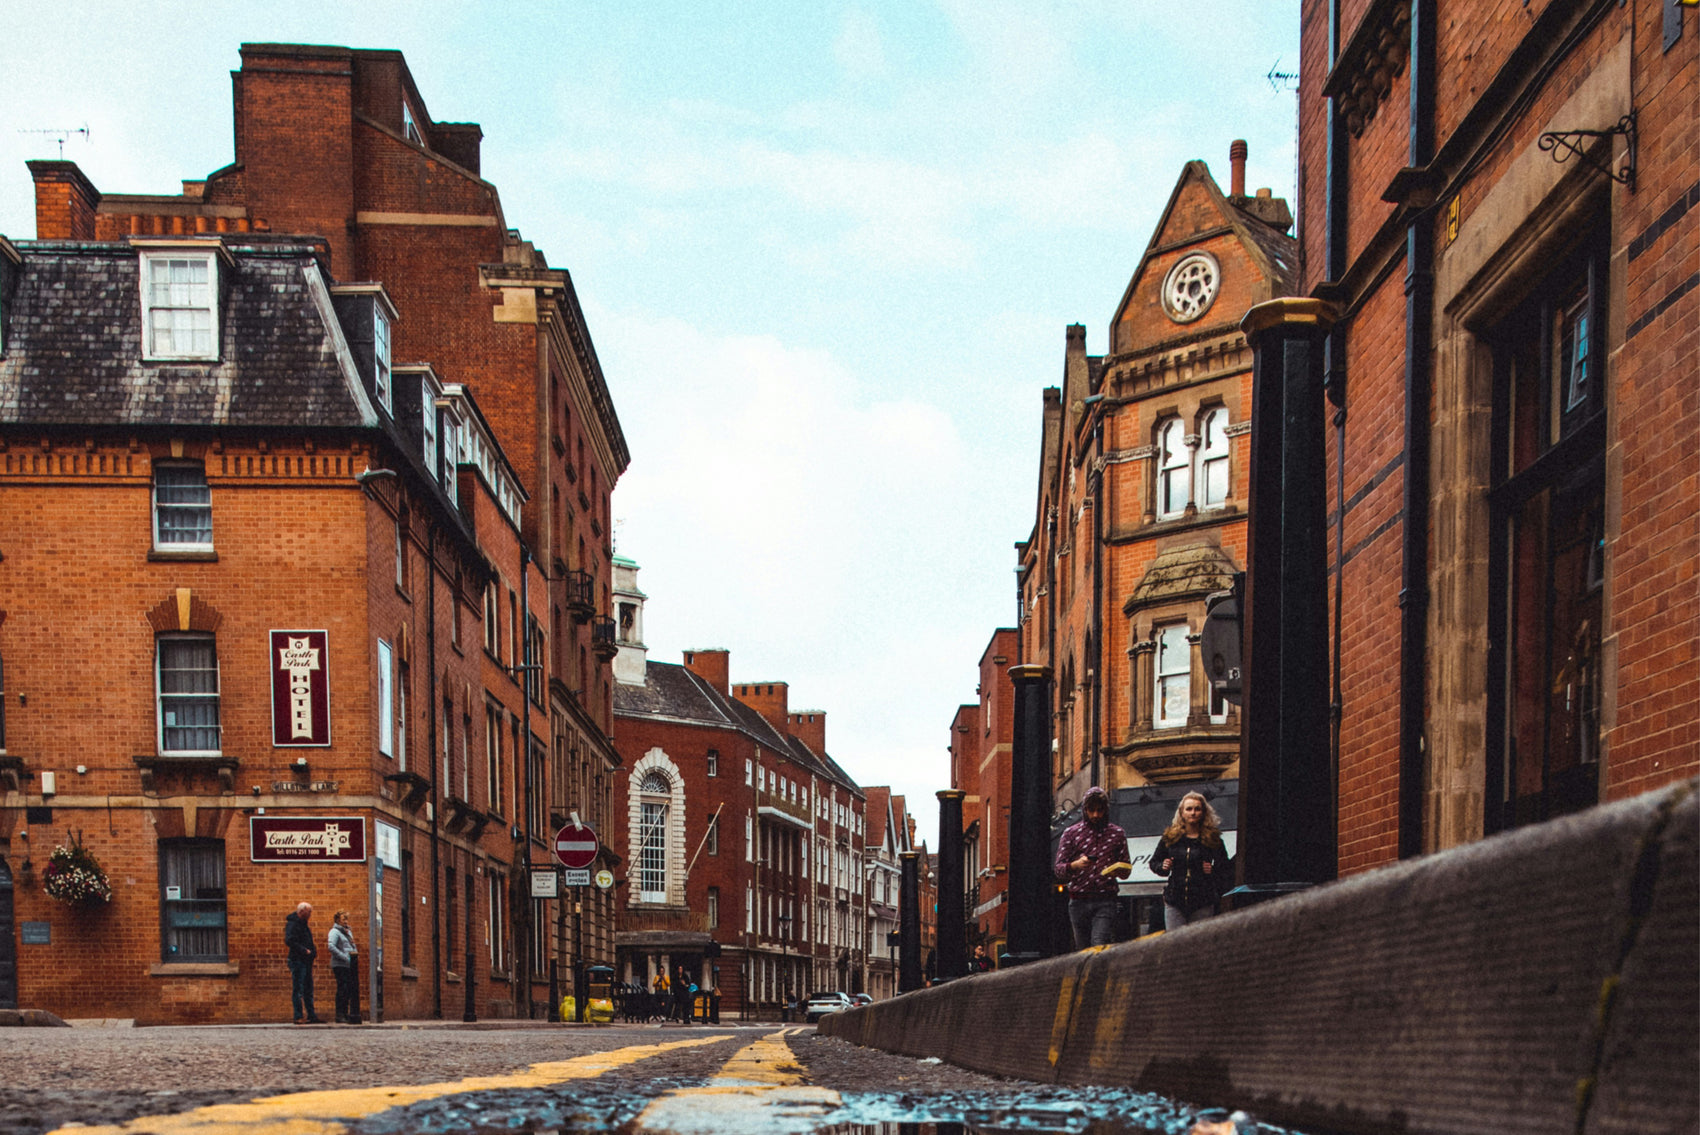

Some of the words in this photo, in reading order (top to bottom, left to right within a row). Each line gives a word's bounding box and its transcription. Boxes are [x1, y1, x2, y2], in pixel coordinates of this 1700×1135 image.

[284, 650, 314, 659] Castle
[284, 659, 311, 667] Park
[292, 675, 309, 730] HOTEL
[269, 833, 296, 845] Castle
[299, 833, 323, 845] Park
[327, 826, 337, 854] HOTEL
